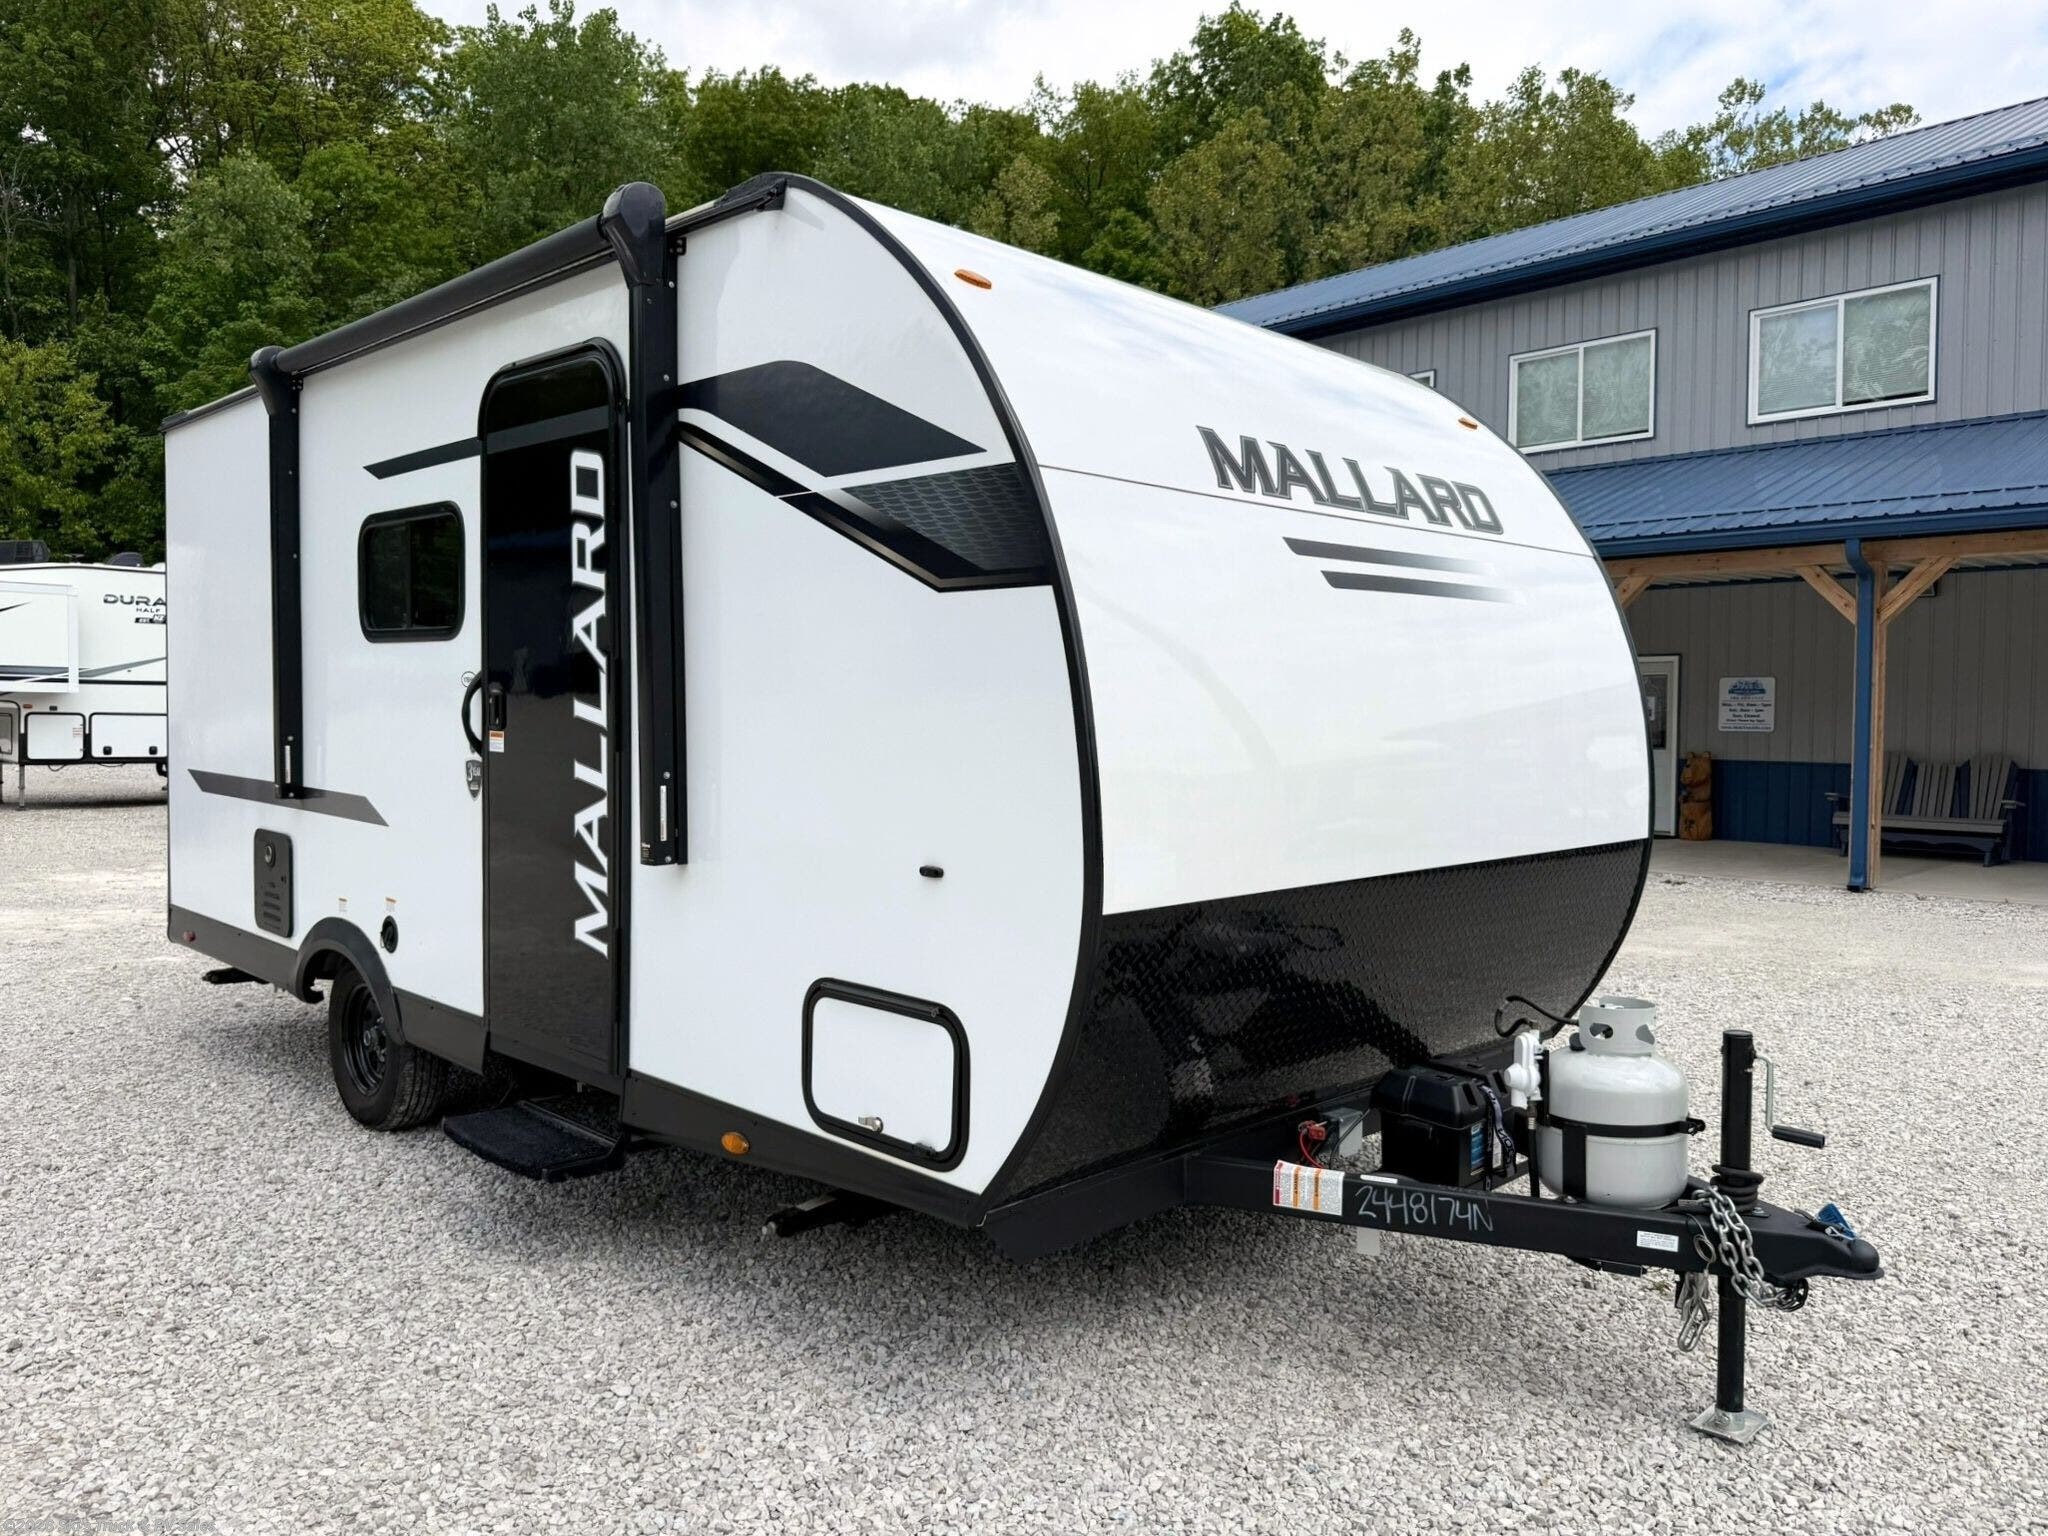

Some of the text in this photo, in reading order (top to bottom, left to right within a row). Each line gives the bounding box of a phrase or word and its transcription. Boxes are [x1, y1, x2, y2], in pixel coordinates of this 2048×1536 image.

[1196, 425, 1504, 535] MALLARD
[570, 450, 608, 958] MALLARD
[1355, 1185, 1494, 1233] 2448174N
